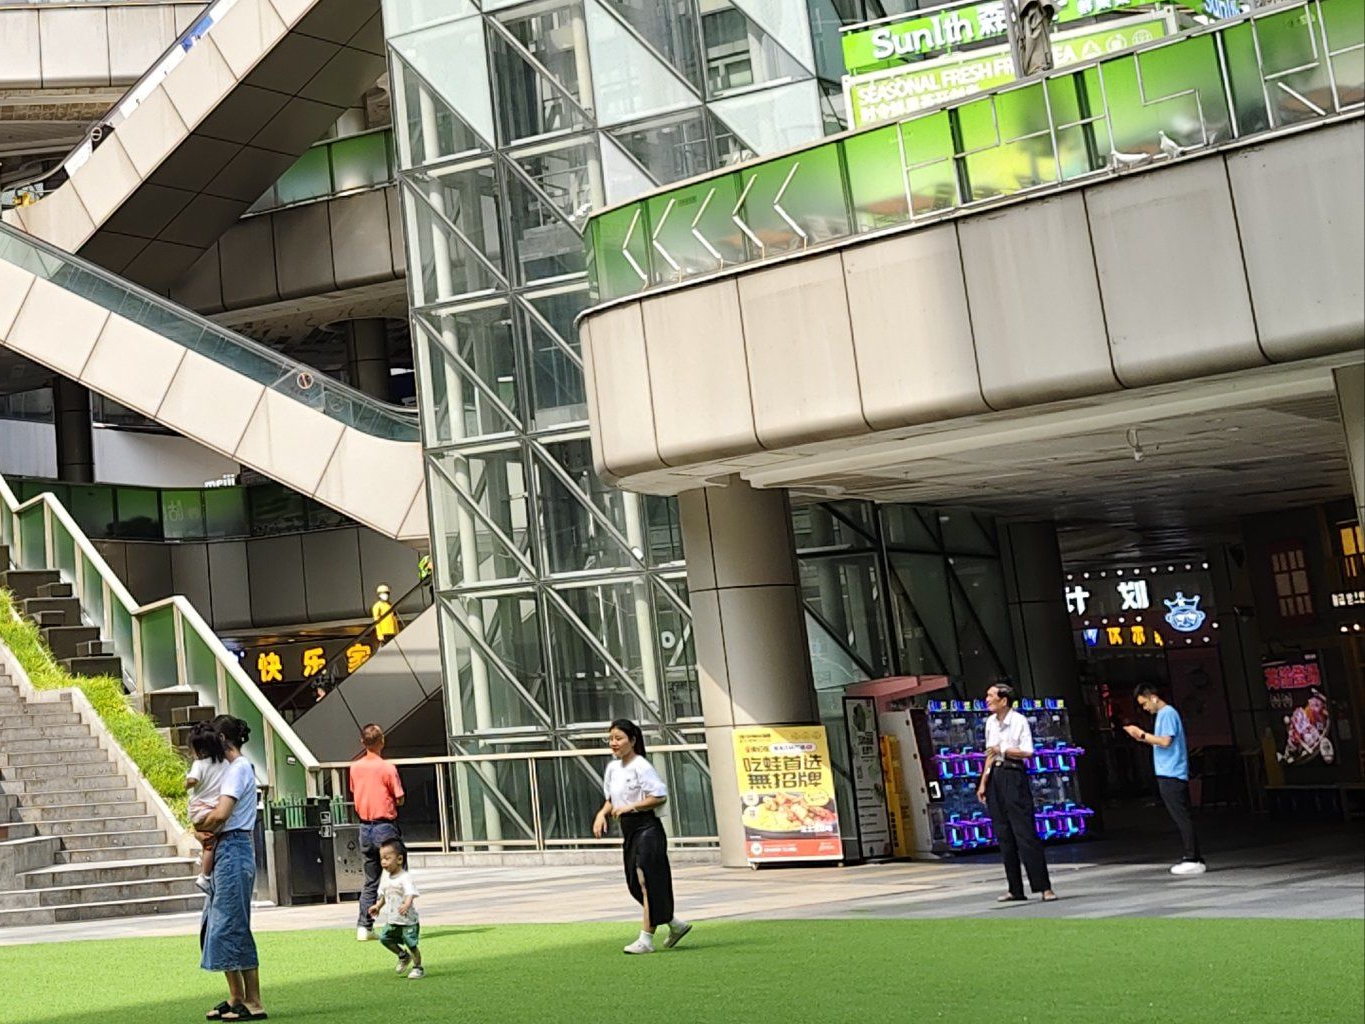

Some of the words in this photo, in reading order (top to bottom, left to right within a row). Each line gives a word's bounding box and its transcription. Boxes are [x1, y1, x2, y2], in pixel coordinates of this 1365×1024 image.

[743, 754, 822, 772] 吃蛙首选
[748, 772, 822, 789] 無招牌
